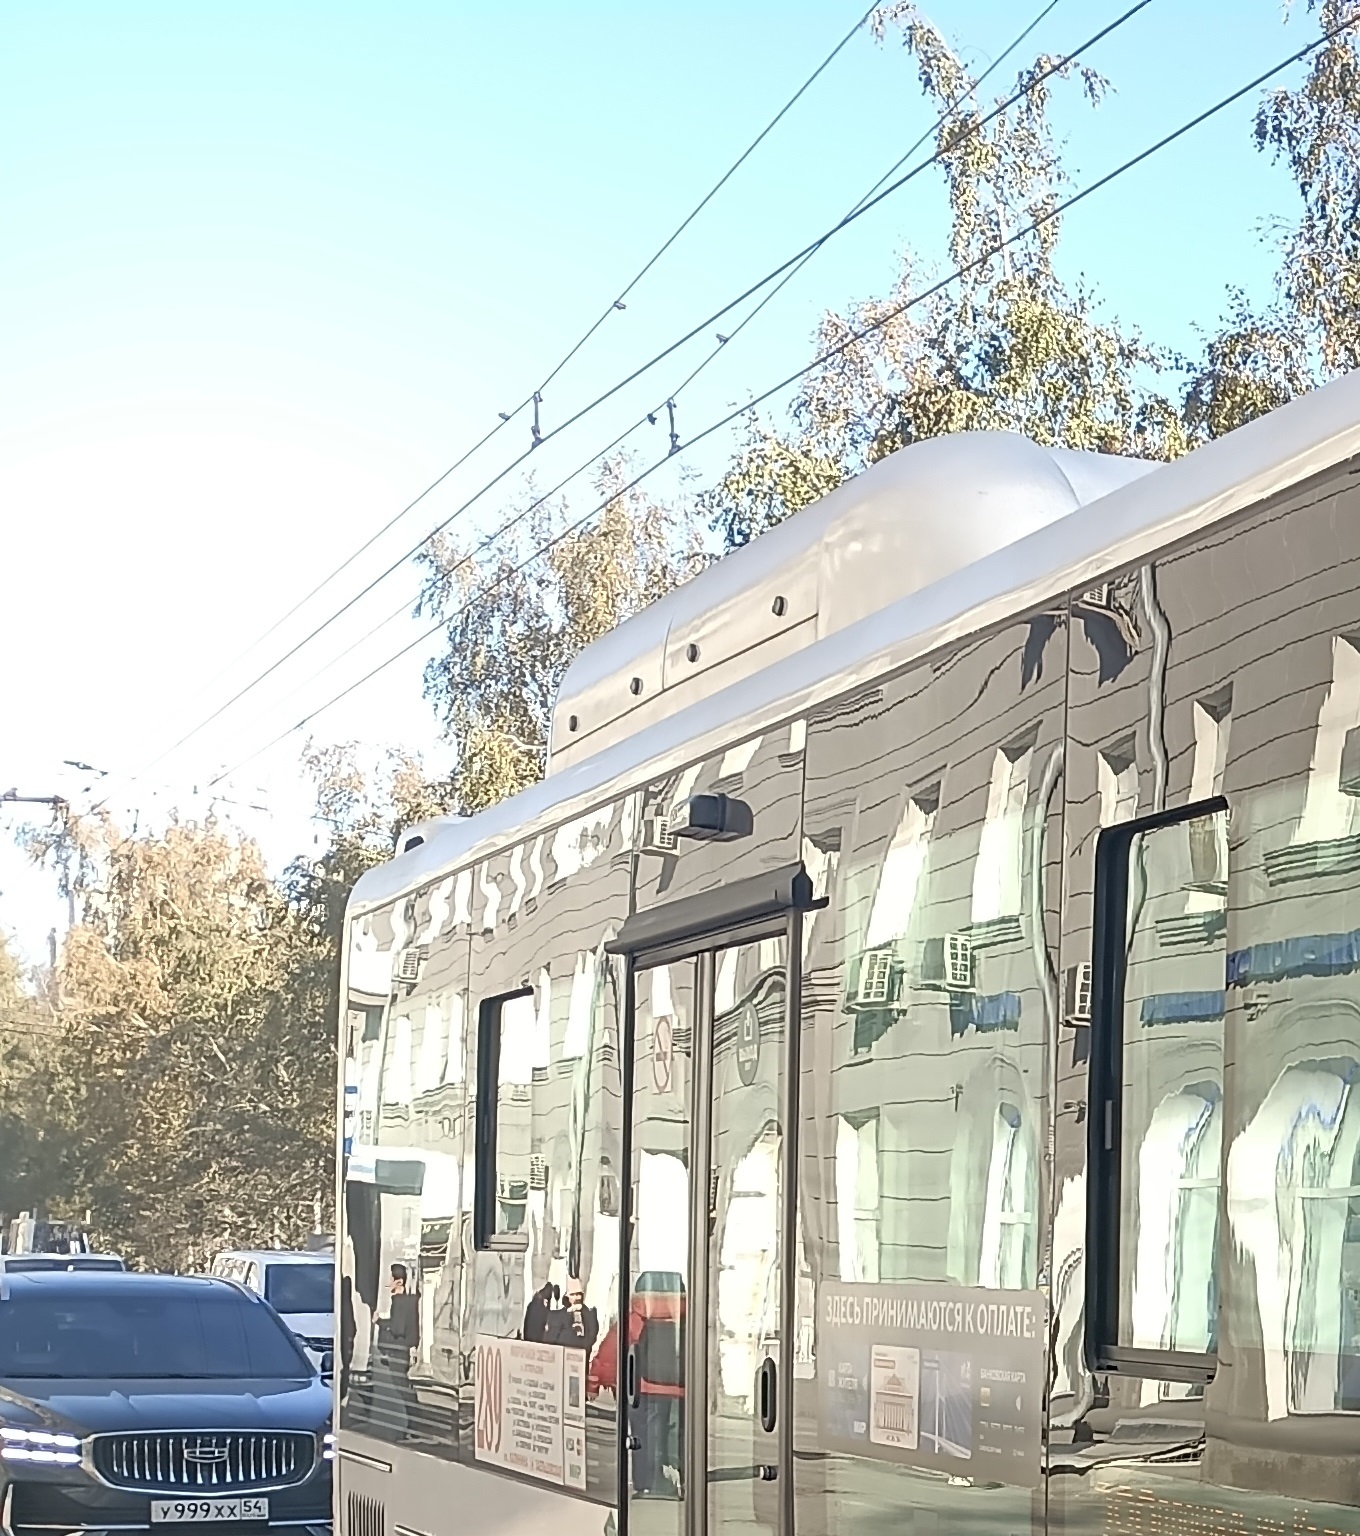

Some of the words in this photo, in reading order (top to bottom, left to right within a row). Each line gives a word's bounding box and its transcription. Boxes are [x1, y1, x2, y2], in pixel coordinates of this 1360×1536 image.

[825, 1295, 862, 1328] ЗДЕСЬ
[863, 1297, 963, 1333] ПРИНИМАЮТСЯ
[965, 1302, 976, 1334] К
[976, 1303, 1036, 1339] ОПЛАТЕ:
[477, 1344, 502, 1454] 289
[243, 1500, 263, 1513] 54
